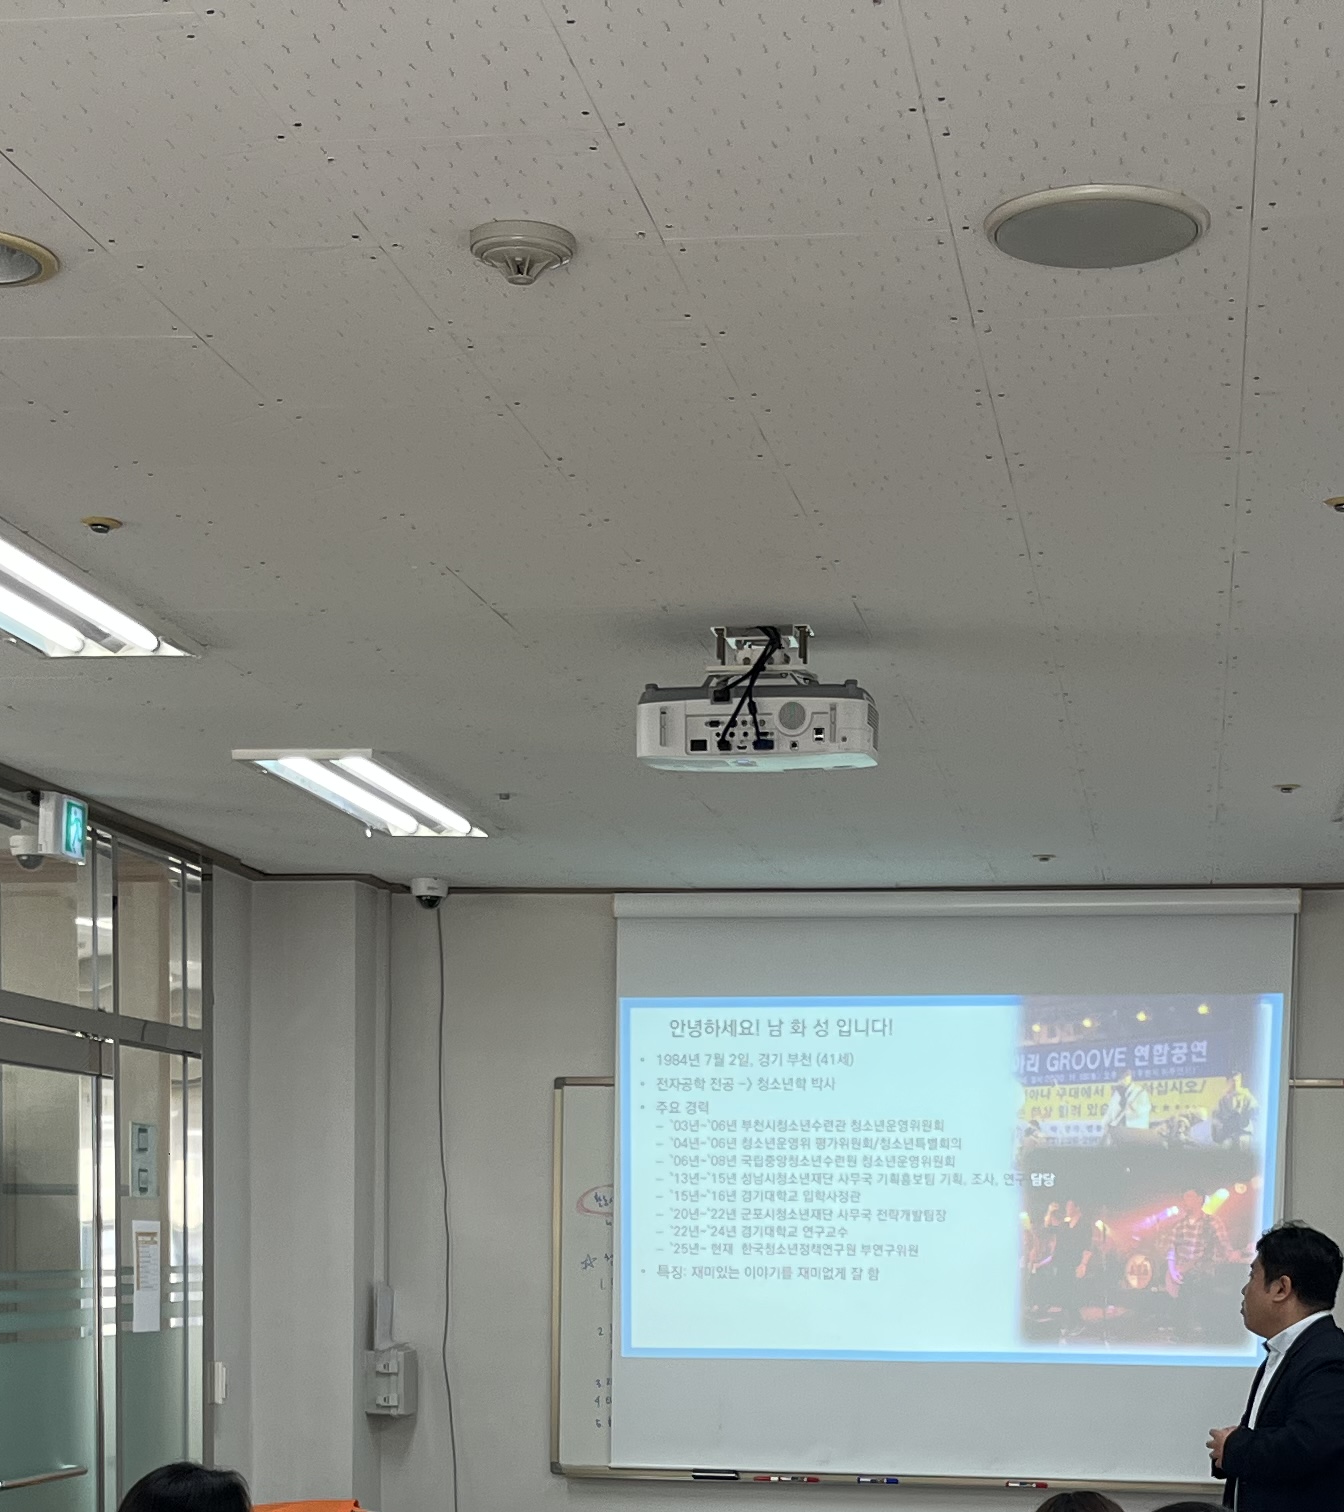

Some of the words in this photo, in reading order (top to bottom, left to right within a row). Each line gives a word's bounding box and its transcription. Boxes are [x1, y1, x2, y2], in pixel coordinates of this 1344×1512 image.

[669, 1018, 761, 1038] 안녕하세요!
[767, 1018, 784, 1038] 남
[789, 1018, 807, 1038] 화
[813, 1018, 830, 1038] 성
[836, 1017, 894, 1038] 입니다!
[656, 1052, 701, 1068] 1984년
[705, 1053, 725, 1068] 7월
[758, 1052, 783, 1068] 경기
[786, 1052, 813, 1068] 부천
[816, 1051, 855, 1068] (41세)
[1046, 1046, 1127, 1073] GROOVE
[1134, 1040, 1208, 1066] 연합공연
[656, 1077, 706, 1092] 전자공학
[757, 1077, 807, 1092] 청소년학
[811, 1077, 836, 1092] 박사
[656, 1100, 681, 1115] 주요
[685, 1100, 710, 1115] 경력
[838, 1172, 873, 1186] 사무국
[1003, 1173, 1024, 1187] 연구
[1030, 1172, 1056, 1188] 담당
[837, 1208, 872, 1222] 사무국
[802, 1225, 849, 1239] 연구교수
[711, 1243, 734, 1256] 현재
[656, 1264, 687, 1280] 특징:
[691, 1265, 741, 1280] 재미있는
[744, 1266, 793, 1280] 이야기를
[797, 1266, 847, 1281] 재미없게
[851, 1266, 864, 1281] 잘
[867, 1266, 881, 1281] 함
